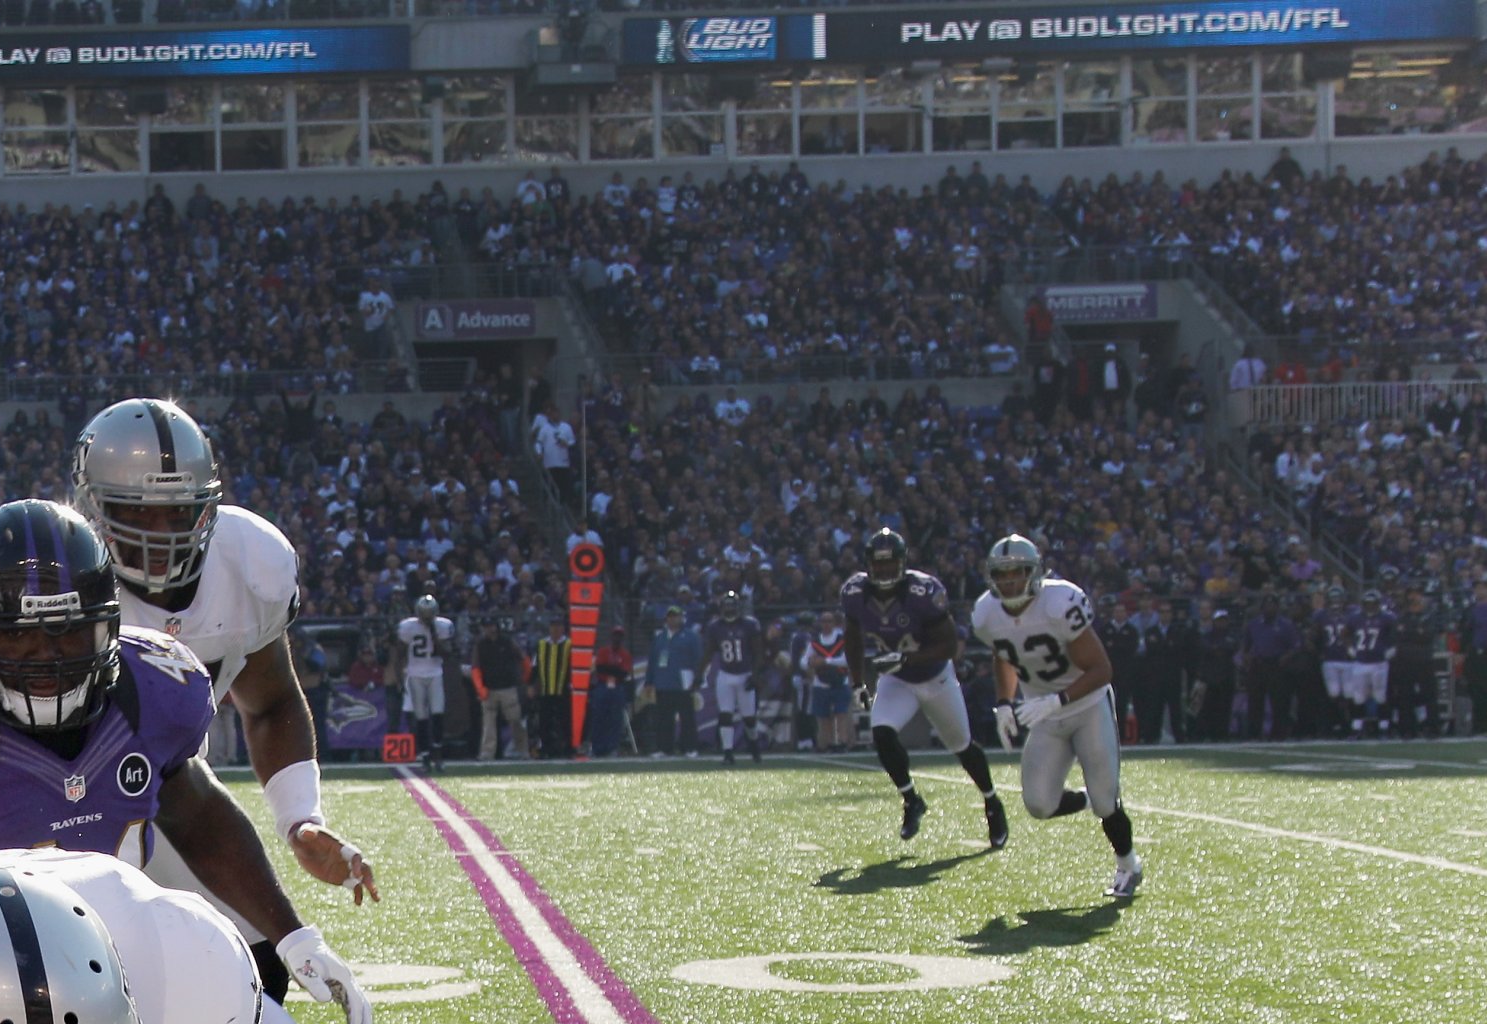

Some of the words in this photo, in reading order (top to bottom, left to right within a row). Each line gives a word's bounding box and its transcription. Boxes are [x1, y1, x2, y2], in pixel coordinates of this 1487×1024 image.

[701, 18, 771, 34] BUD
[901, 21, 979, 43] PLAY
[988, 19, 1021, 39] @
[1030, 8, 1350, 40] BUDLIGHT.COM/FFL
[685, 32, 774, 51] LIGHT
[46, 47, 71, 64] @
[78, 42, 317, 63] BUDLIGHT.COM/FFL
[1046, 295, 1144, 311] MERRITT
[424, 308, 444, 330] A
[458, 311, 531, 329] Advance
[721, 639, 743, 663] 81
[385, 738, 412, 759] 20
[125, 765, 145, 784] Art
[50, 812, 103, 832] RAVENS
